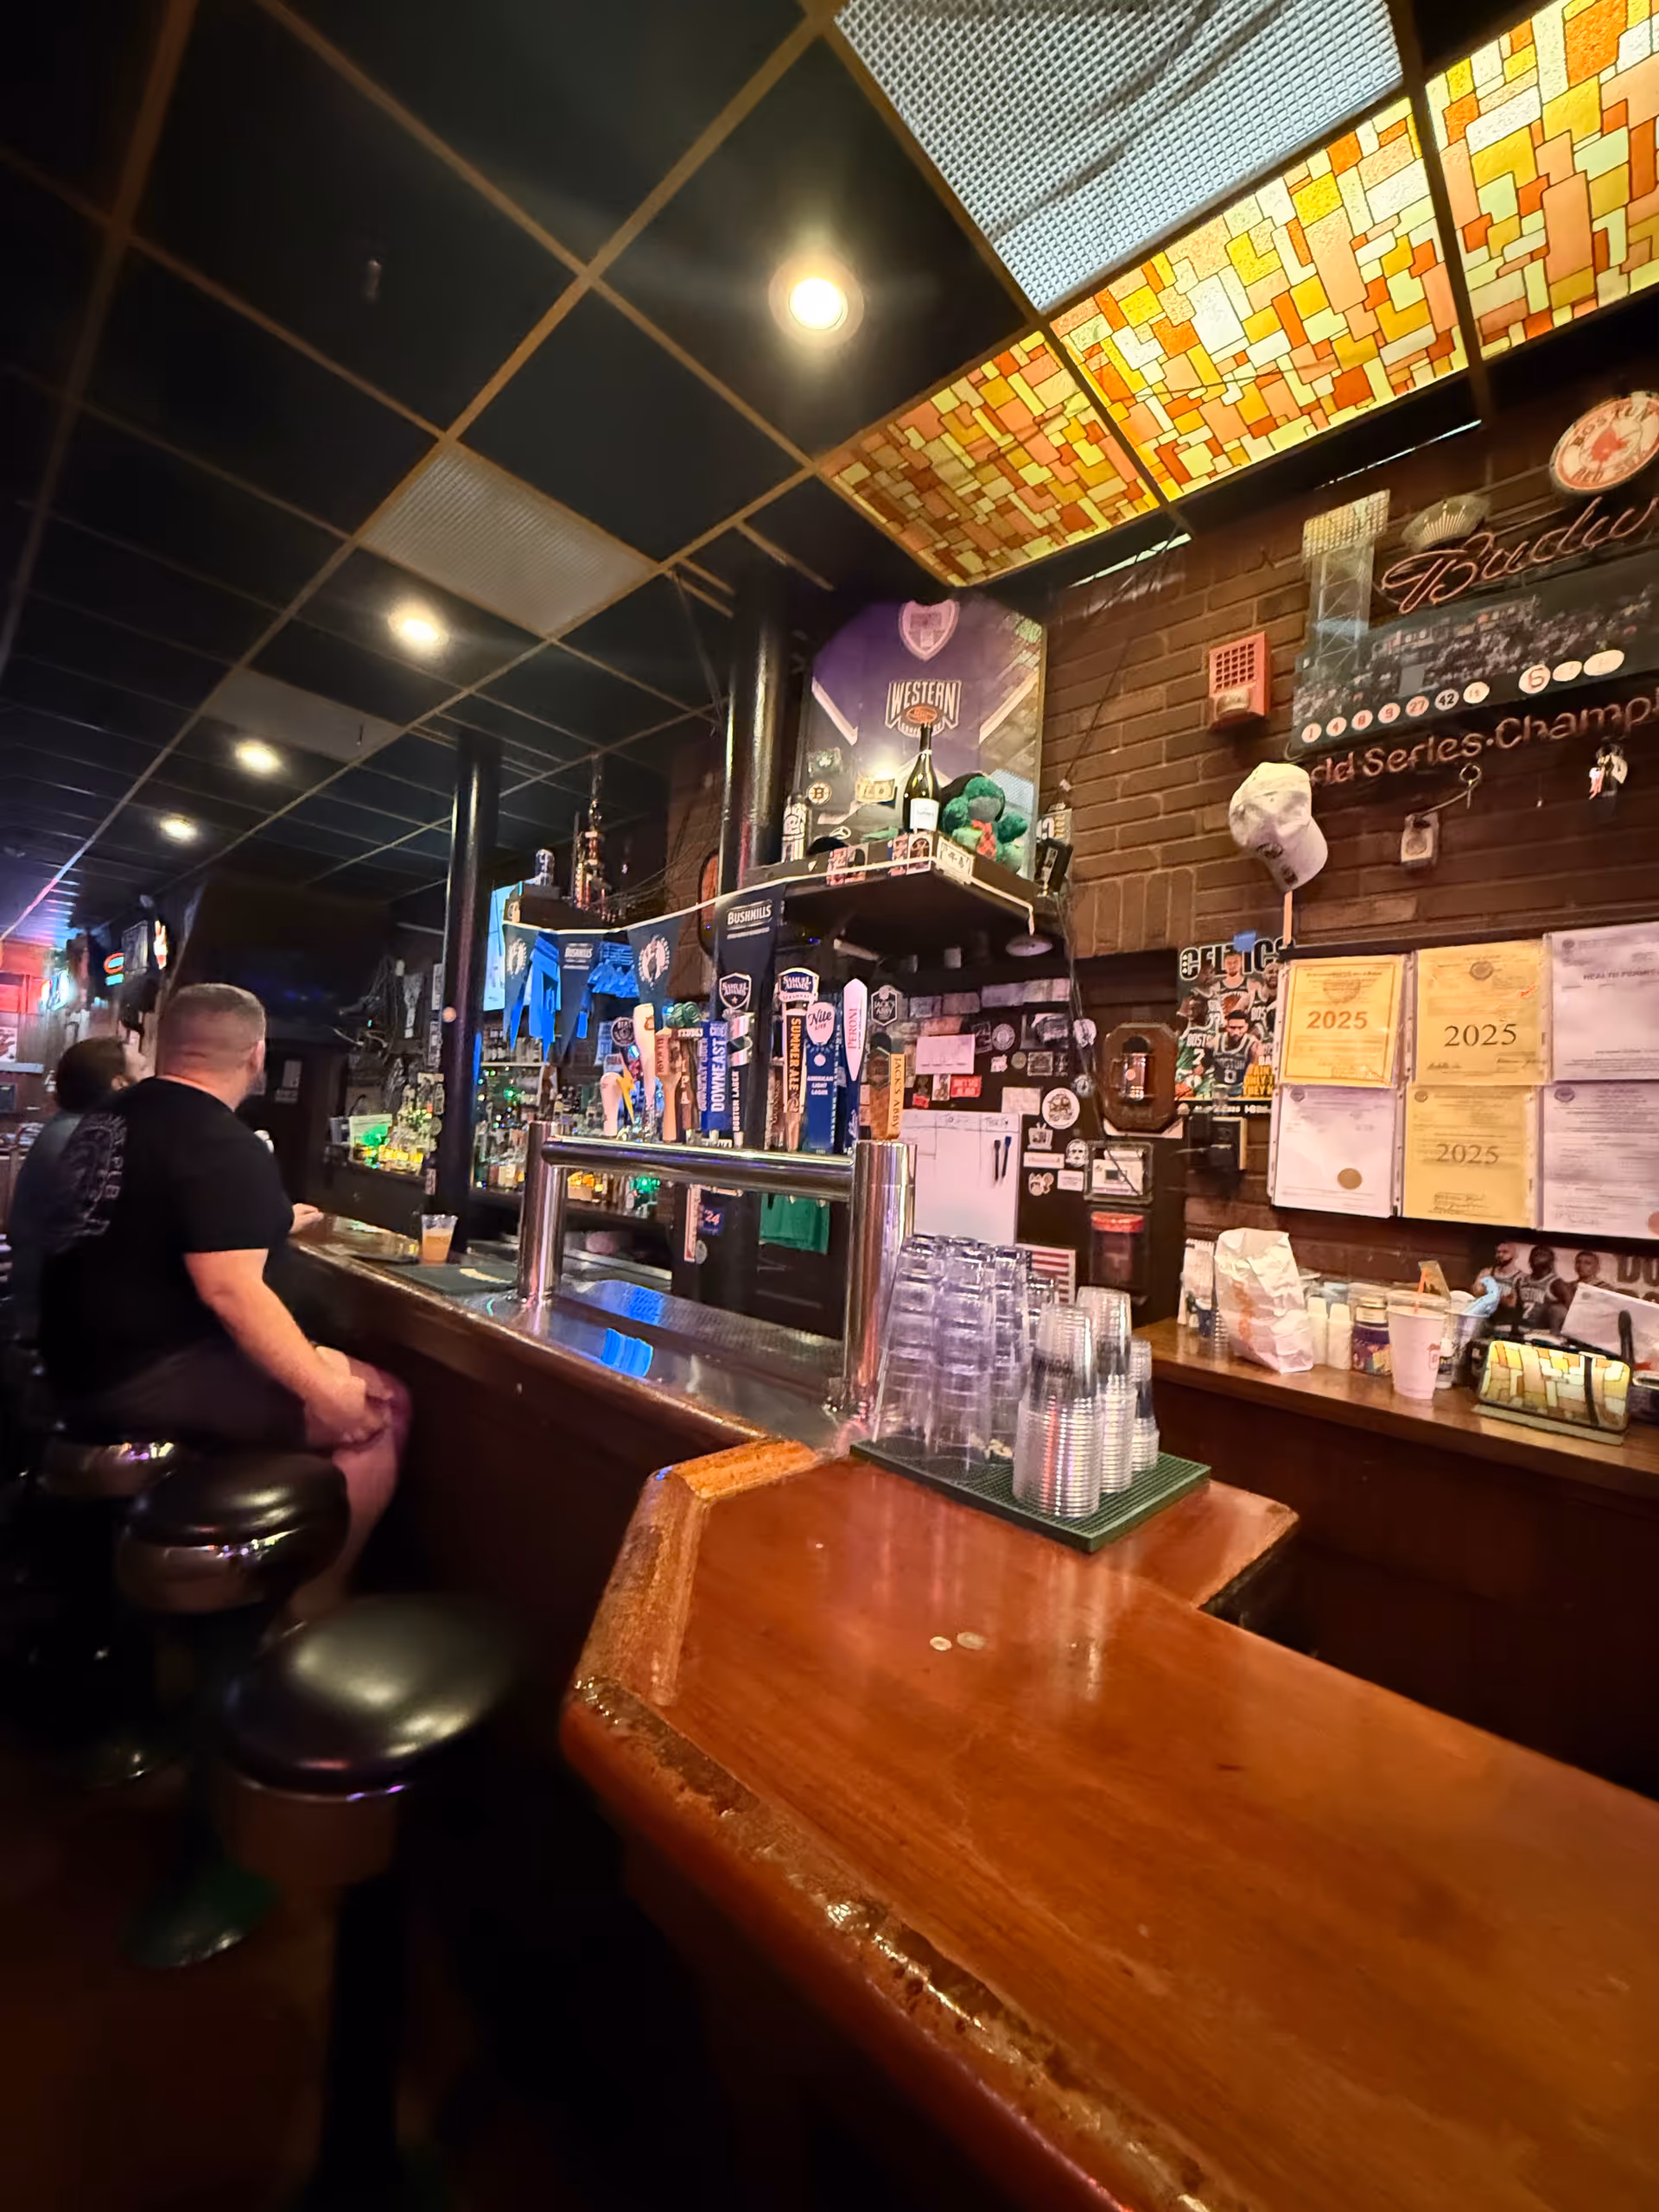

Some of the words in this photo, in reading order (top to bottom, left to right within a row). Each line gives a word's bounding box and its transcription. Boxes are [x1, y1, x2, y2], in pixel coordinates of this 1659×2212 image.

[890, 681, 957, 721] WESTERN
[1409, 700, 1426, 714] 27
[1438, 692, 1455, 706] 42
[1529, 667, 1545, 689] 6
[727, 905, 772, 926] BUSHMILLS
[808, 1010, 832, 1027] Nite
[848, 1007, 859, 1050] PERONI
[1306, 1010, 1368, 1029] 2025
[789, 1017, 802, 1067] SUMMER
[1444, 1024, 1516, 1046] 2025
[710, 1038, 726, 1112] DOWNEAST
[788, 1067, 800, 1090] ALE
[893, 1058, 902, 1095] JACK'S
[891, 1099, 901, 1128] ABBY
[1436, 1143, 1499, 1164] 2025
